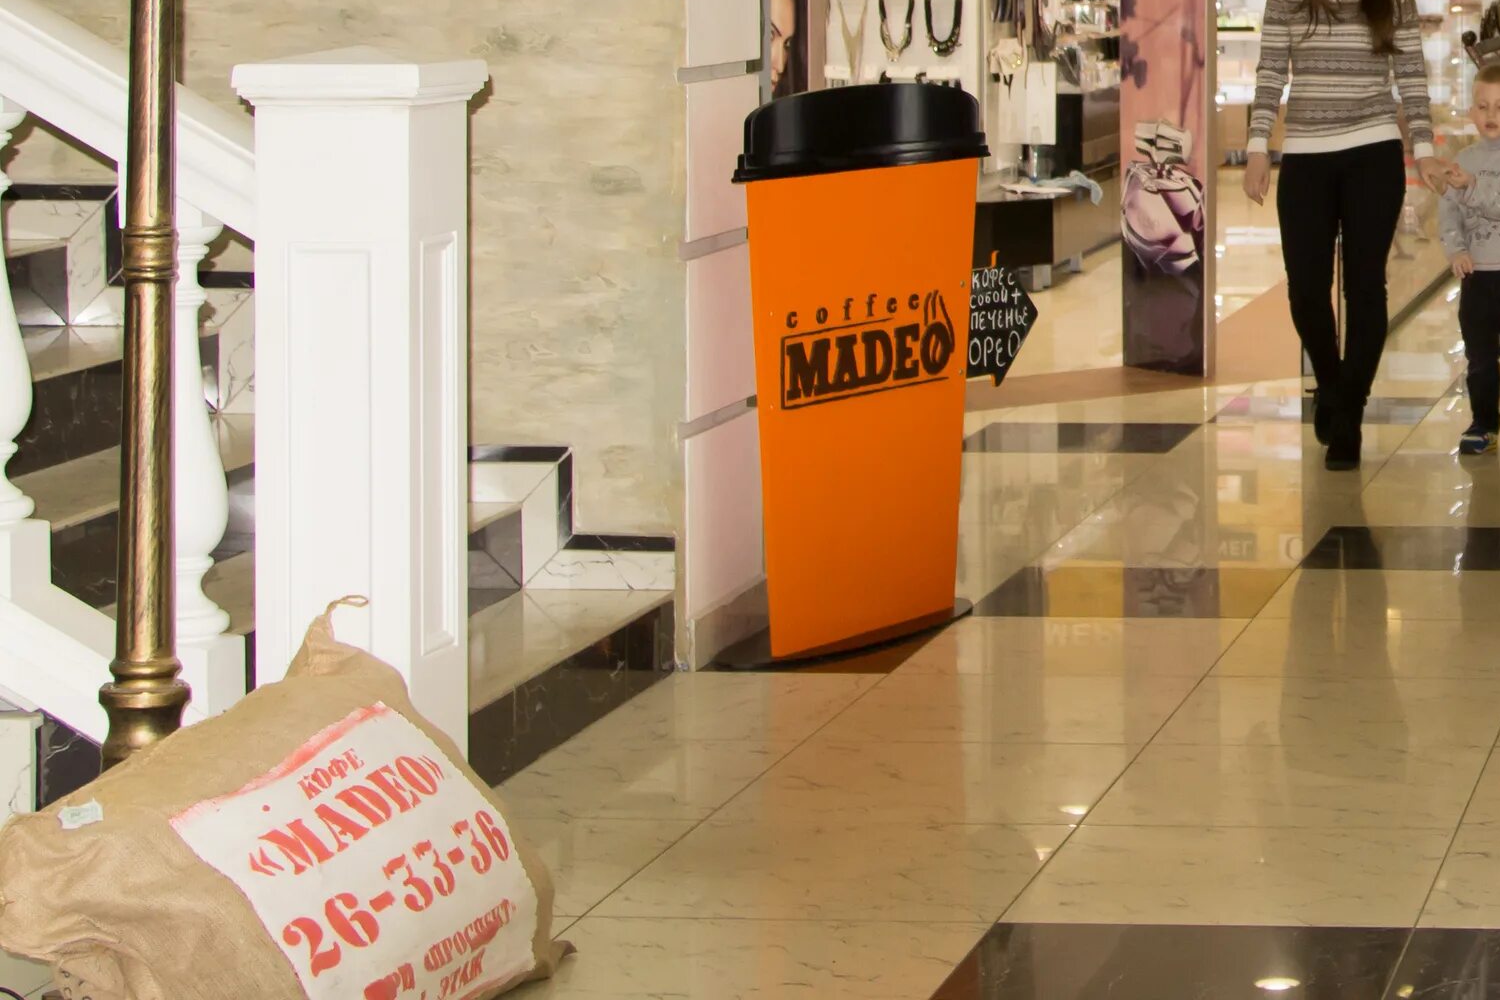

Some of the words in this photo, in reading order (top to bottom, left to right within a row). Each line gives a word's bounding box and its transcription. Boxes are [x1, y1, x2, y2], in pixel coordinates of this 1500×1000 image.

[971, 267, 1005, 290] КОФЕ
[786, 293, 920, 328] coffee
[970, 306, 1028, 331] ПЕЧЕНЬЕ
[786, 321, 951, 401] MADEO
[968, 330, 1020, 367] ОРЕО
[297, 747, 365, 800] КОФЕ
[281, 809, 510, 978] 26-33-36
